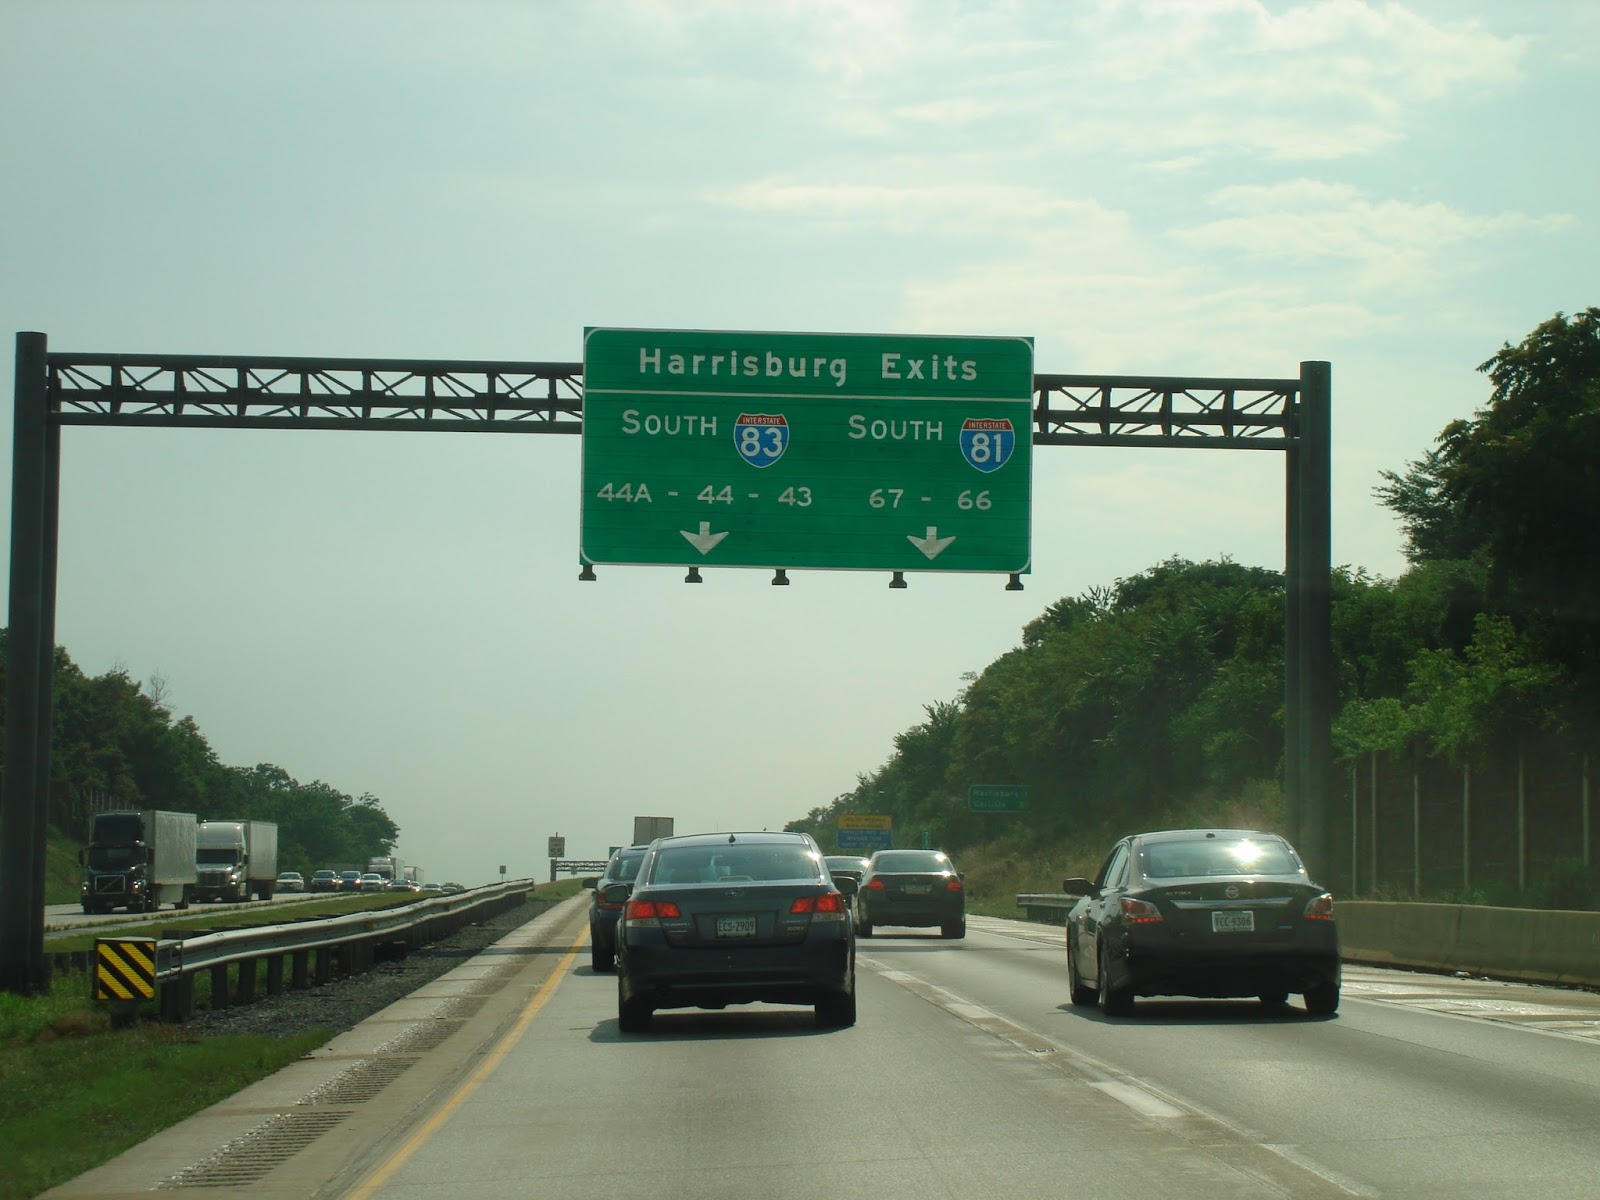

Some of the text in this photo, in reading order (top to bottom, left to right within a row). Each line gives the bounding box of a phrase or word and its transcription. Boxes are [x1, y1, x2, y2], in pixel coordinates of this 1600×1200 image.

[639, 347, 978, 387] Harrisburg Exits
[622, 409, 718, 436] SOUTH
[742, 417, 781, 425] INTERSTATE
[848, 414, 944, 441] SOUTH
[968, 421, 1007, 429] INTERSTATE
[740, 426, 783, 458] 83
[970, 432, 1002, 463] 81
[597, 483, 652, 503] 44A
[697, 485, 734, 504] 44
[778, 486, 812, 507] 43
[869, 488, 904, 508] 67
[957, 490, 992, 510] 66
[550, 848, 563, 856] 55
